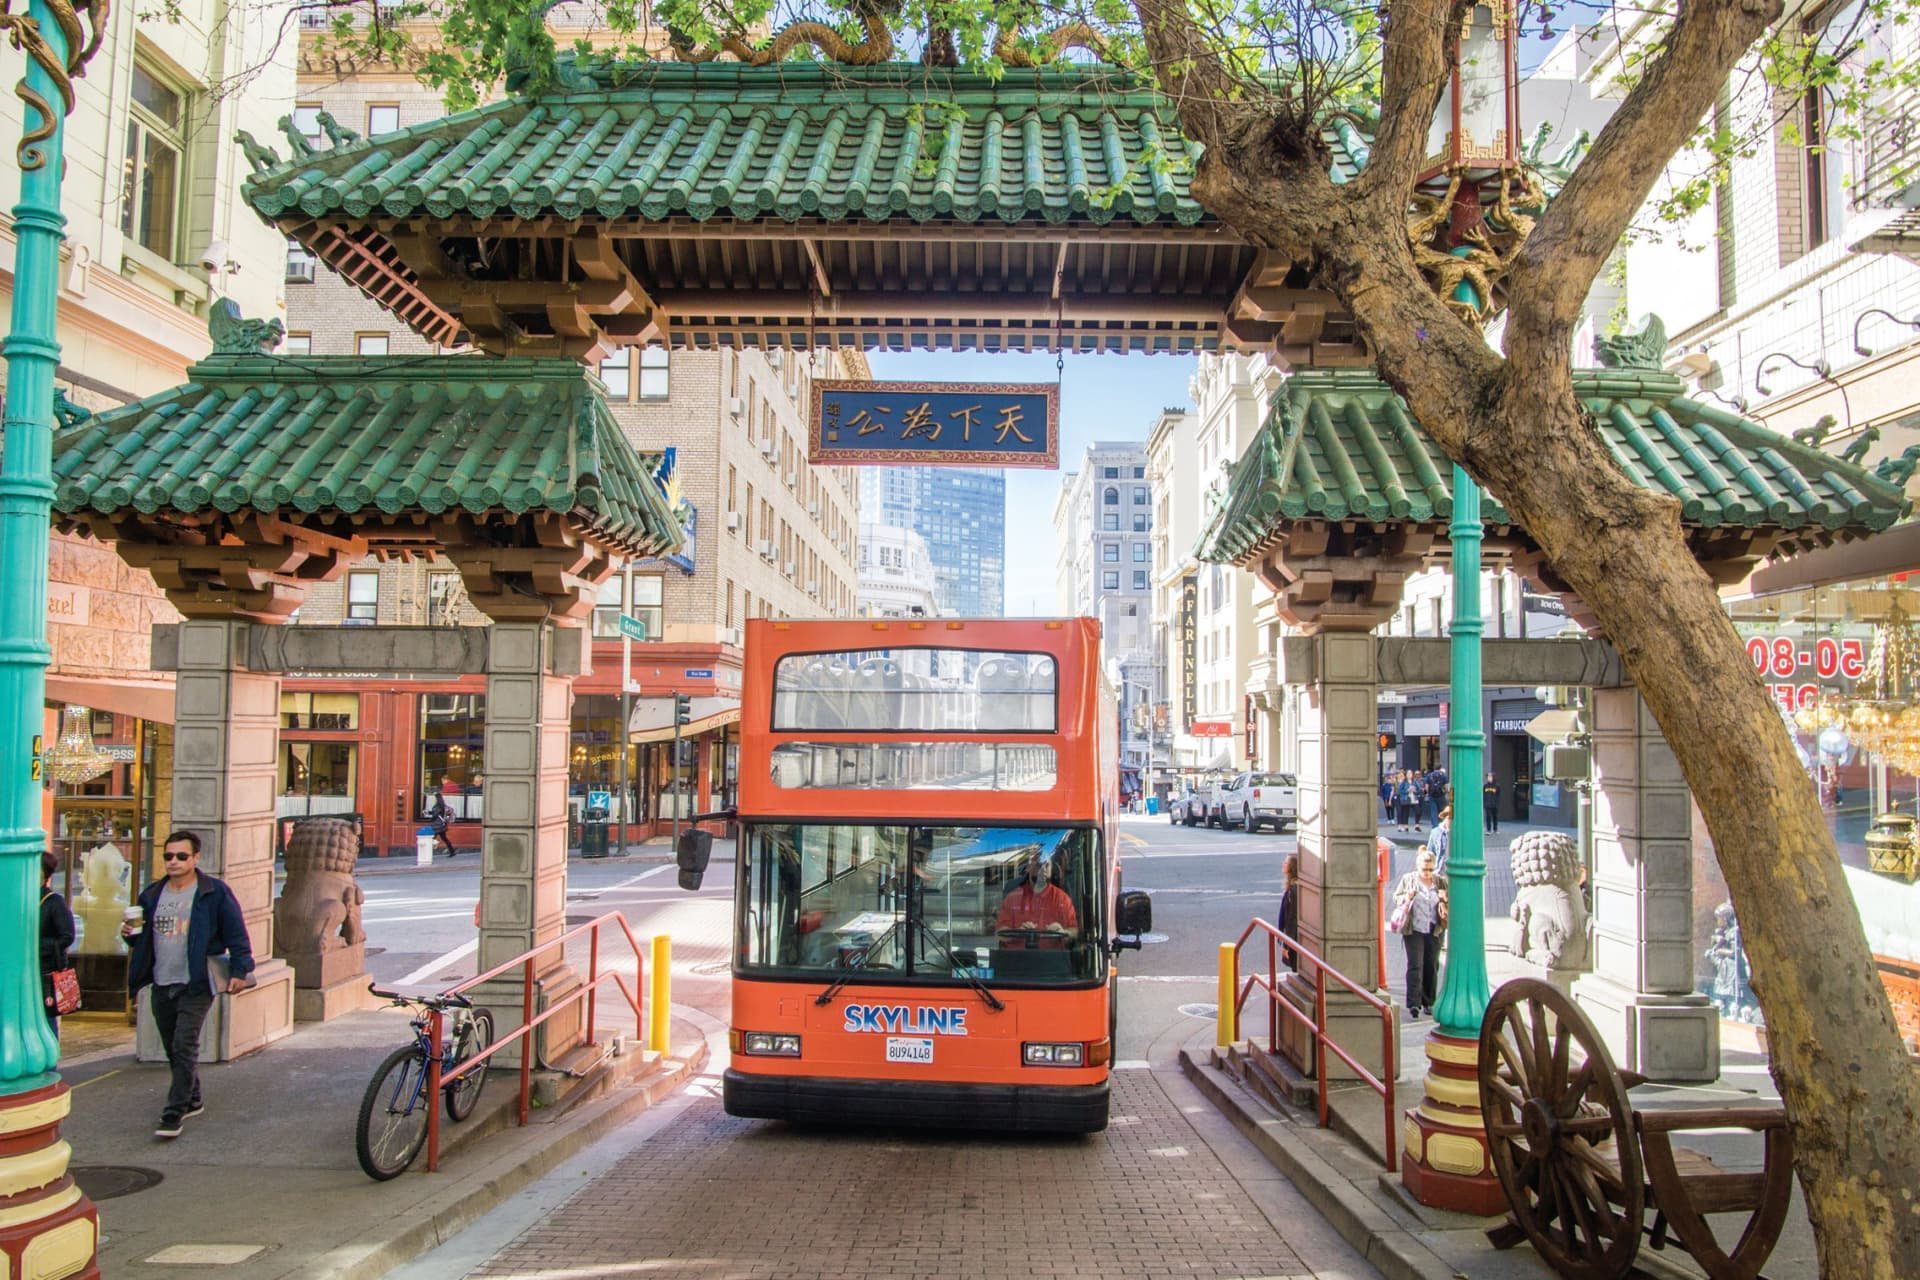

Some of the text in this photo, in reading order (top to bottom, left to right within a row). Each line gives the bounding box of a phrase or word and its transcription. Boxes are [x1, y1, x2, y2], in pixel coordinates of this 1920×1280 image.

[845, 401, 1033, 444] 天下為公
[624, 620, 641, 635] Grant
[1185, 599, 1195, 727] FARINELLI
[97, 746, 136, 759] Press
[843, 1004, 967, 1036] SKYLINE
